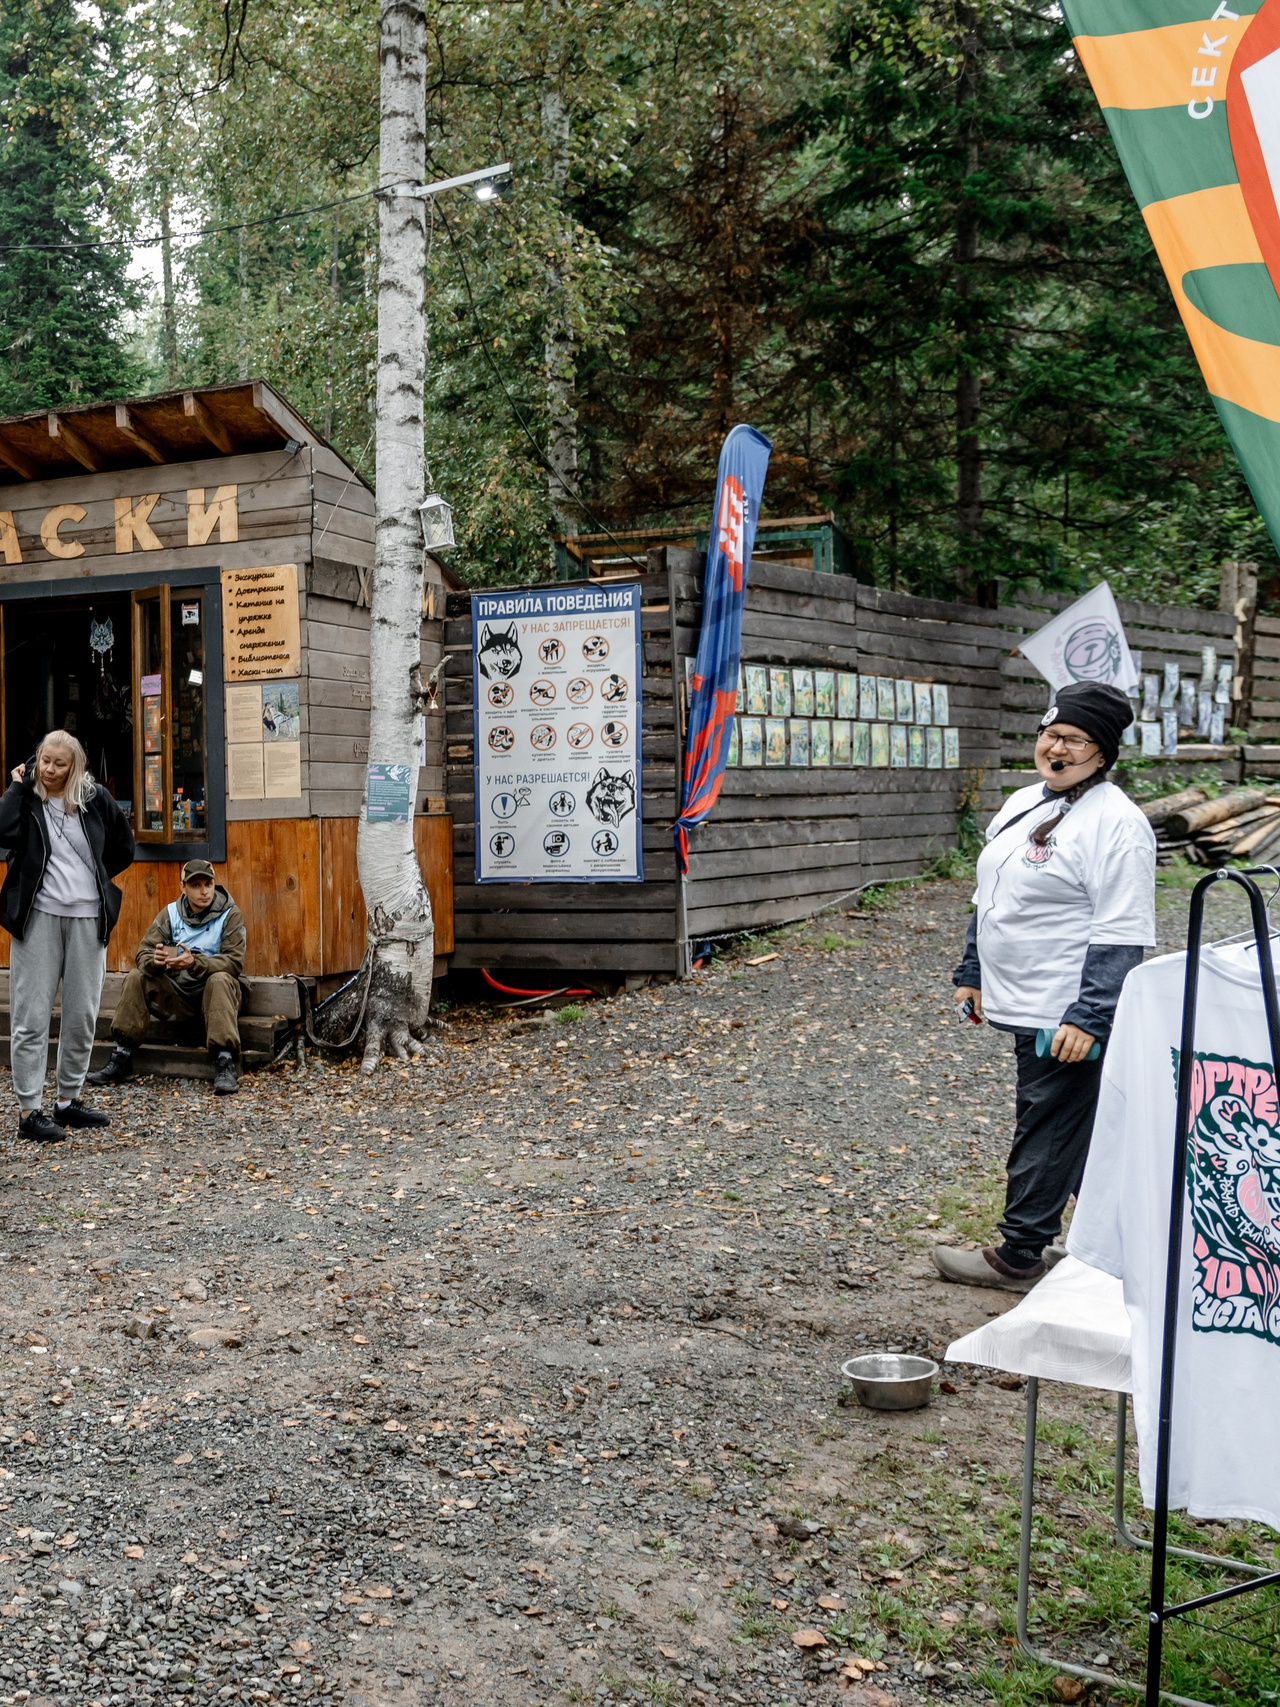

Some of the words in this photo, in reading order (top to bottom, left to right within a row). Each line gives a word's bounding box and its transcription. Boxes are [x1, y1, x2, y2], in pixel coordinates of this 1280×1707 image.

[235, 572, 275, 582] Экскурсии
[235, 585, 285, 597] Догтрекинг
[236, 600, 273, 609] Катание
[479, 597, 543, 616] ПРАВИЛА
[547, 591, 633, 612] ПОВЕДЕНИЯ
[238, 613, 272, 624] упряжке
[522, 623, 528, 634] У
[531, 622, 550, 633] НАС
[553, 617, 631, 632] ЗАПРЕЩАЕТСЯ!
[237, 626, 266, 637] Аренда
[240, 640, 285, 650] снаряжения
[238, 667, 283, 677] Хаски-шоп
[486, 775, 492, 785] У
[494, 774, 514, 785] НАС
[516, 772, 590, 784] РАЗРЕШАЕТСЯ!
[1188, 1059, 1280, 1133] ОРТРЕ
[1201, 1255, 1243, 1299] 10
